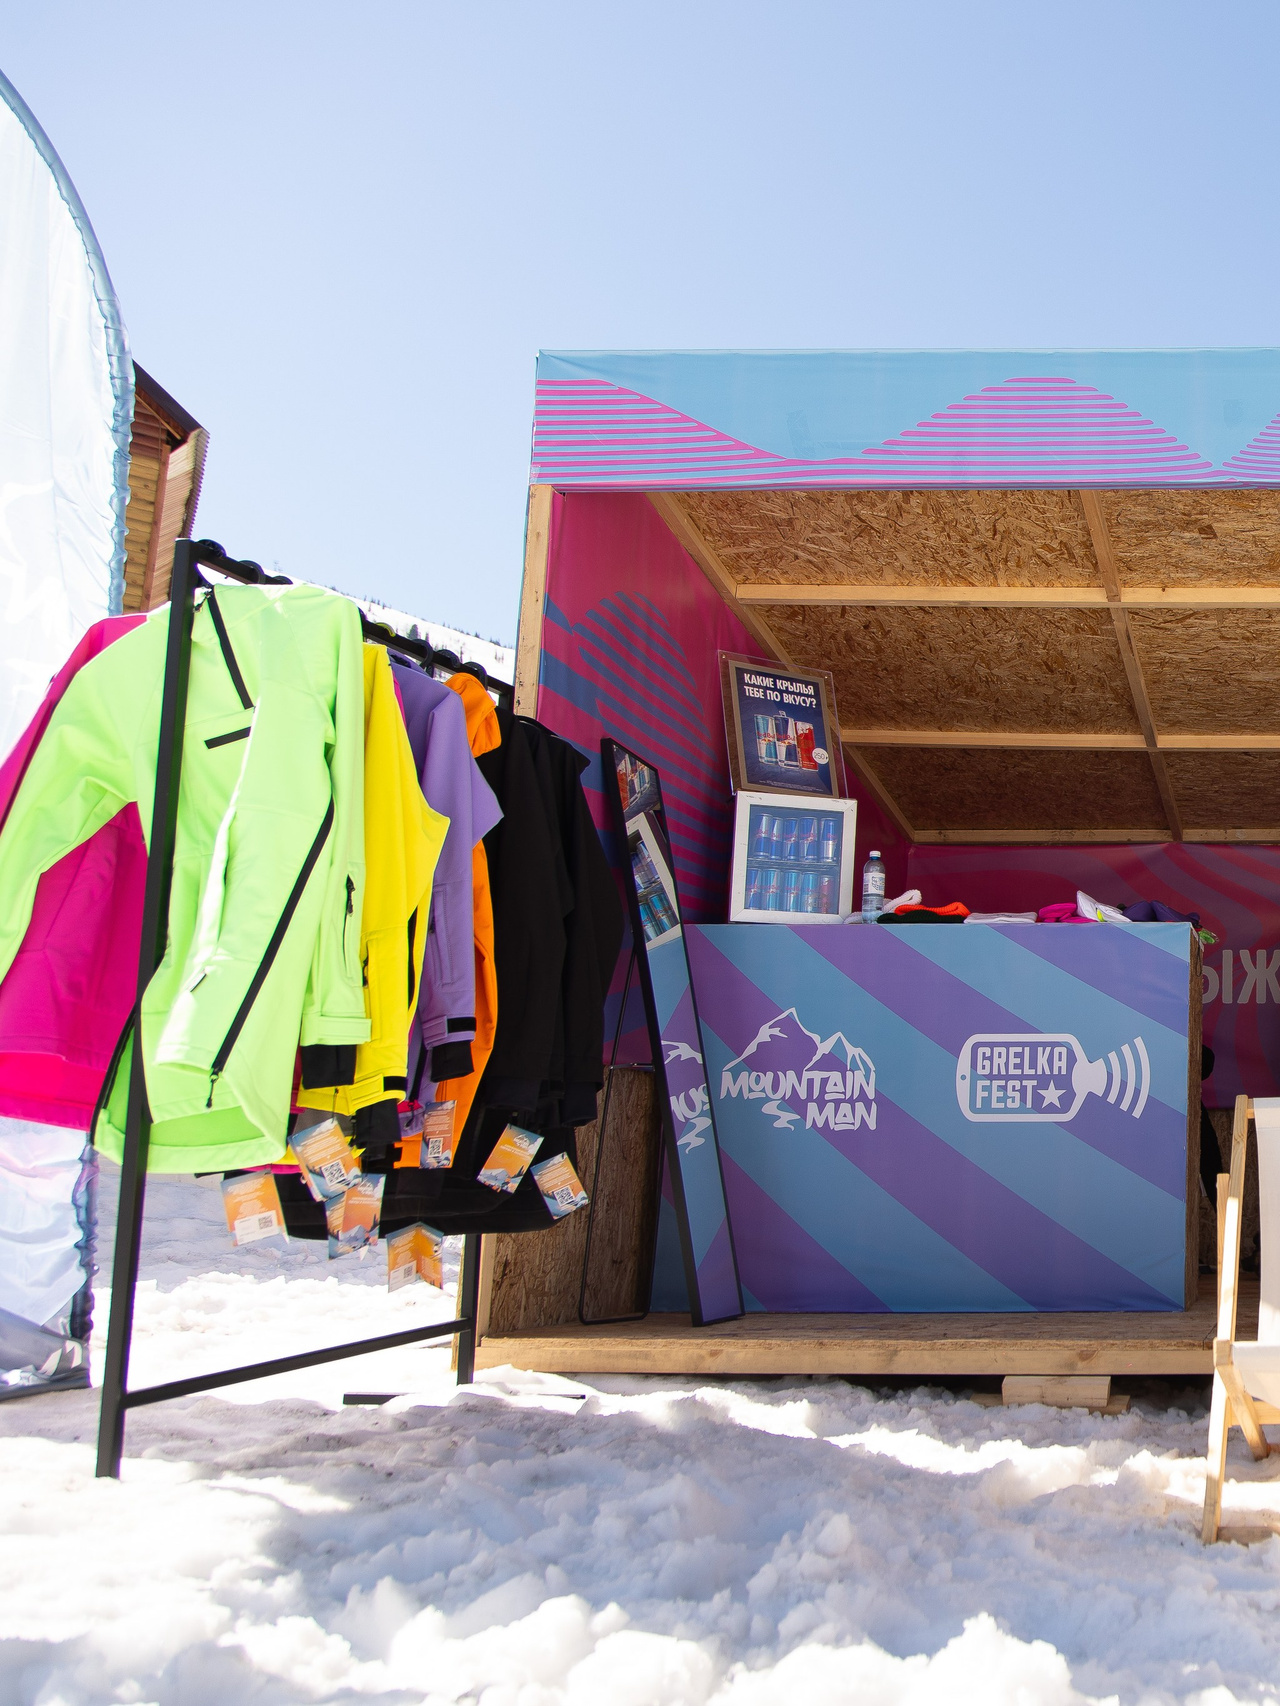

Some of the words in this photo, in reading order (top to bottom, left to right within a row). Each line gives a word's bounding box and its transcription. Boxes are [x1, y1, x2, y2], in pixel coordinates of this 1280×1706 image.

[743, 673, 775, 689] КАКИЕ
[776, 680, 815, 696] КРЫЛЬЯ
[743, 686, 765, 699] ТЕБЕ
[766, 690, 781, 702] ПО
[783, 693, 817, 708] ВКУСУ?
[976, 1046, 1068, 1075] GRELKA
[721, 1068, 876, 1100] MOUNTAIN
[975, 1080, 1037, 1108] FEST
[805, 1100, 877, 1131] MAN
